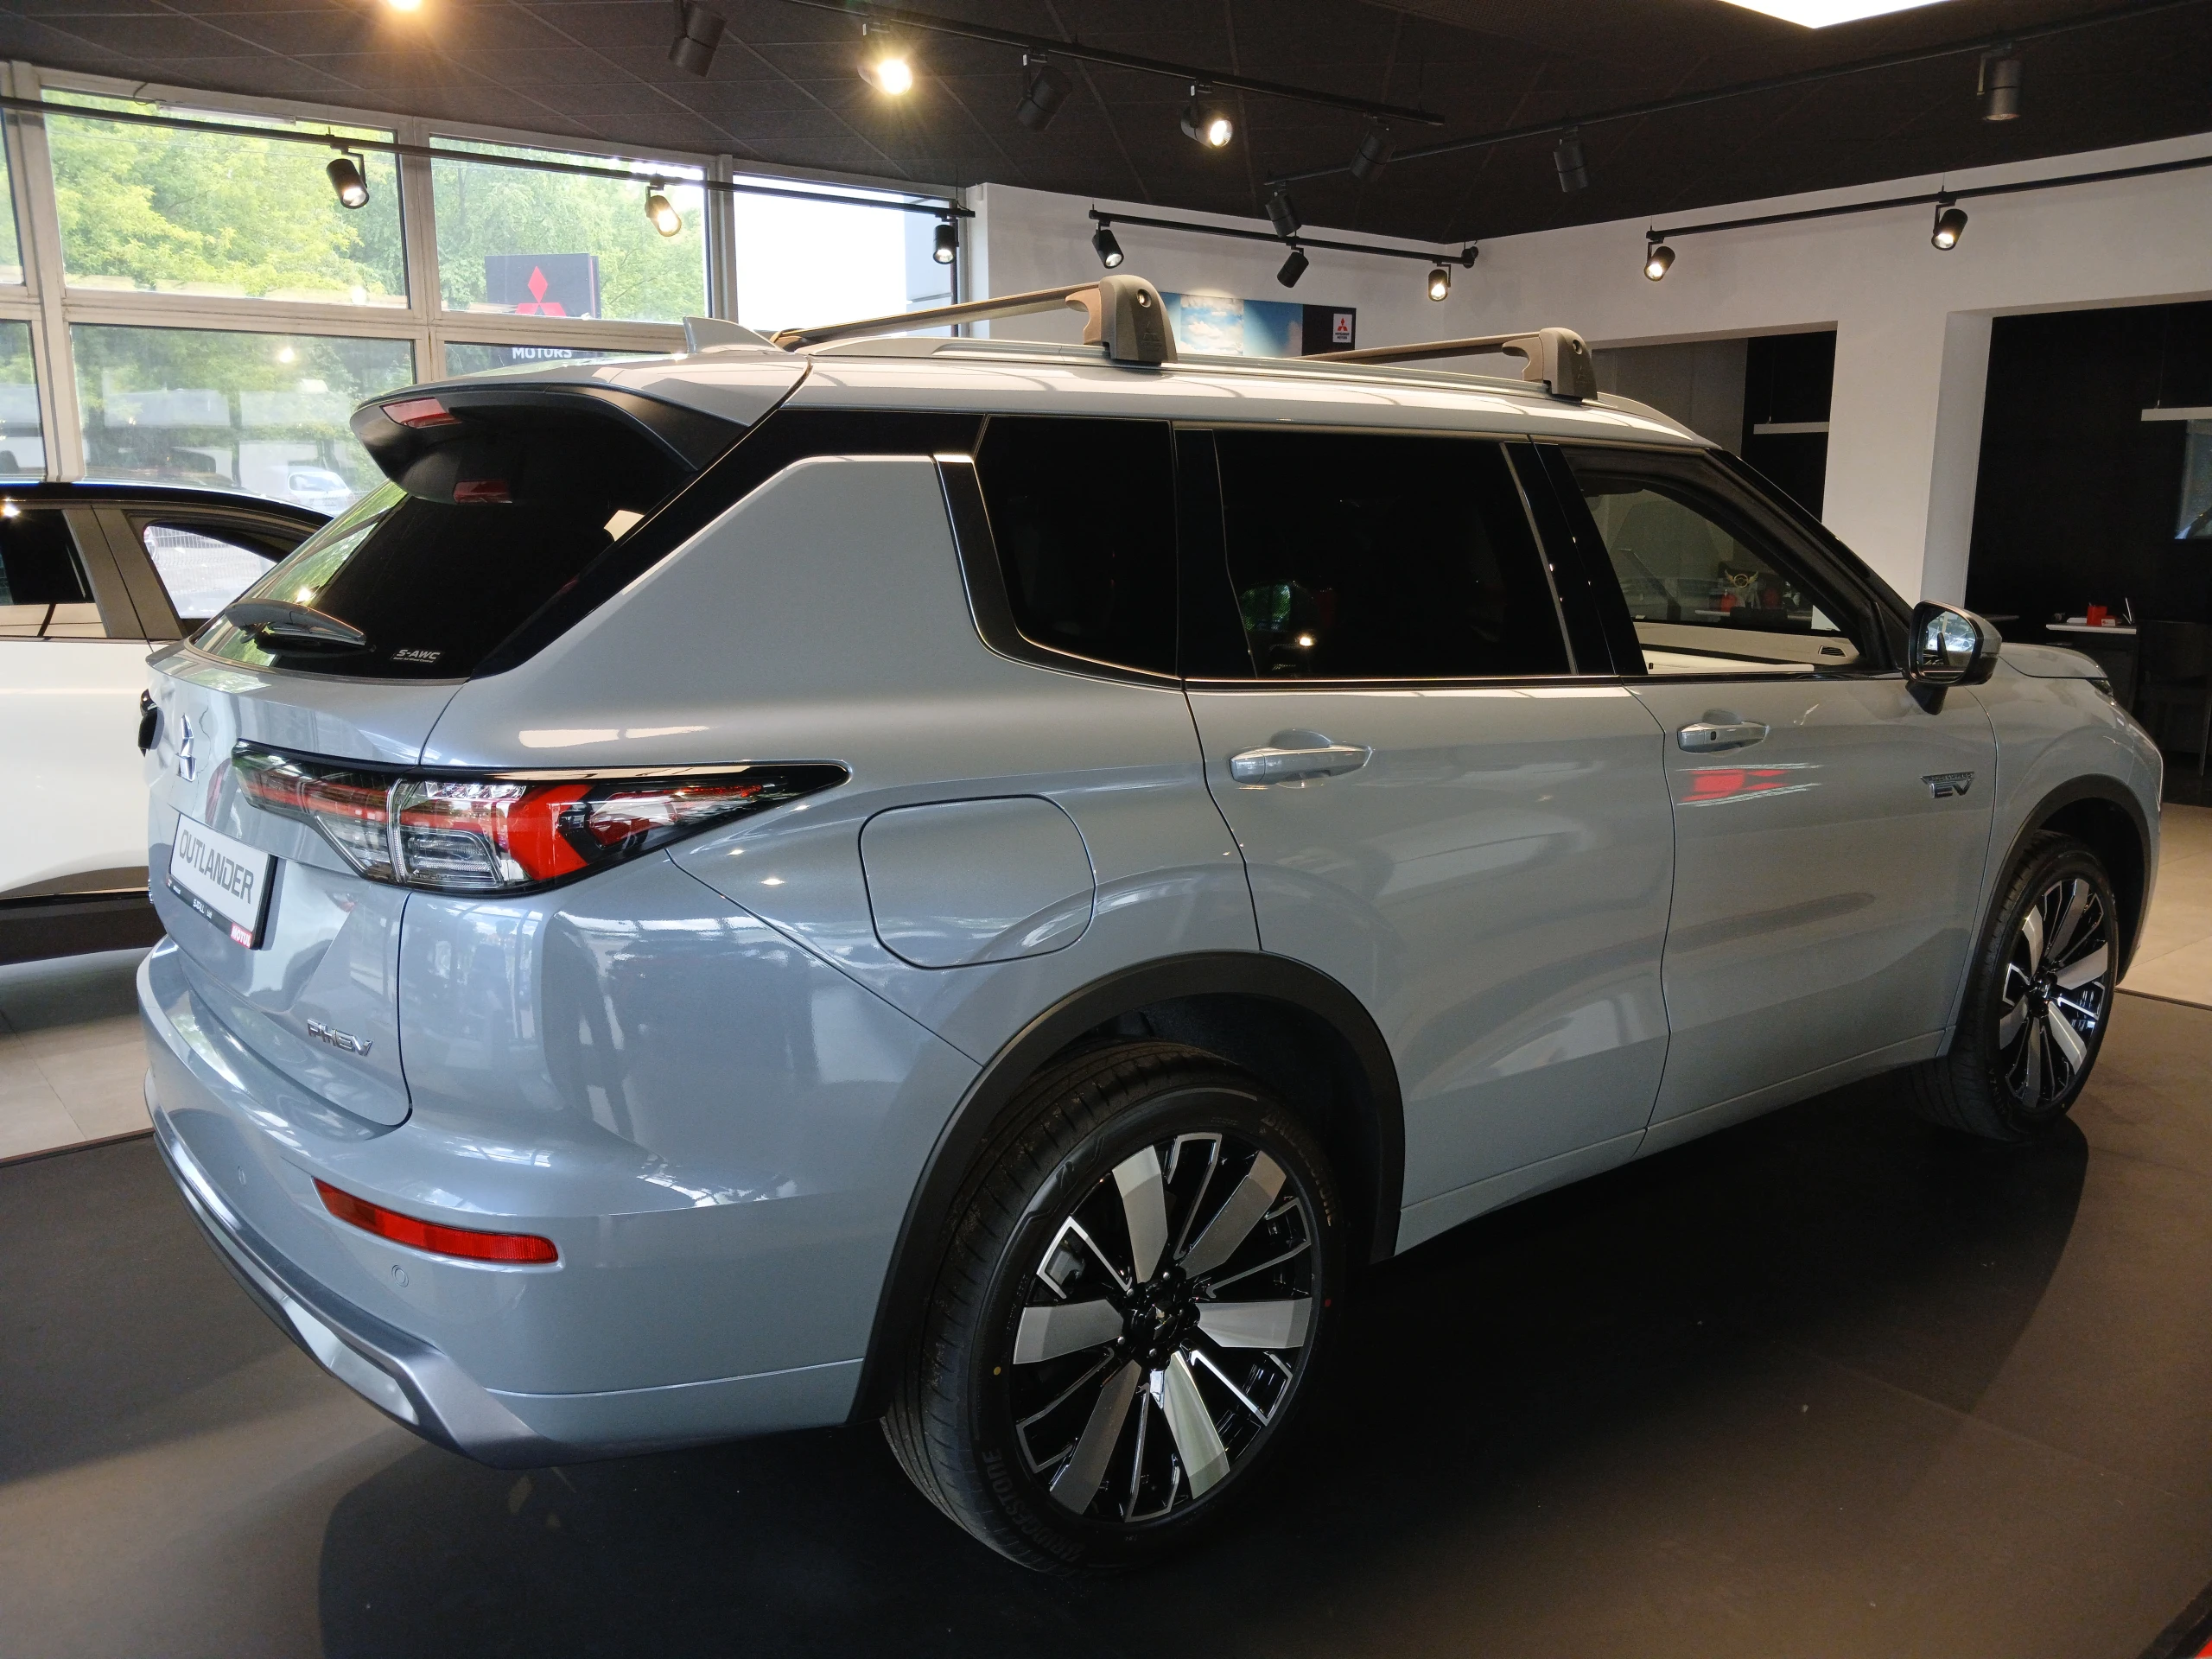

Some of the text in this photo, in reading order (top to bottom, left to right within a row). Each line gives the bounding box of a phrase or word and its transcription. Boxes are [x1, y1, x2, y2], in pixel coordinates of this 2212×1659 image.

[512, 347, 572, 359] MOTORS
[397, 649, 441, 659] S-AWC
[179, 830, 254, 904] OUTLANDER
[231, 925, 251, 948] MOTUL
[308, 1018, 374, 1056] PHEV
